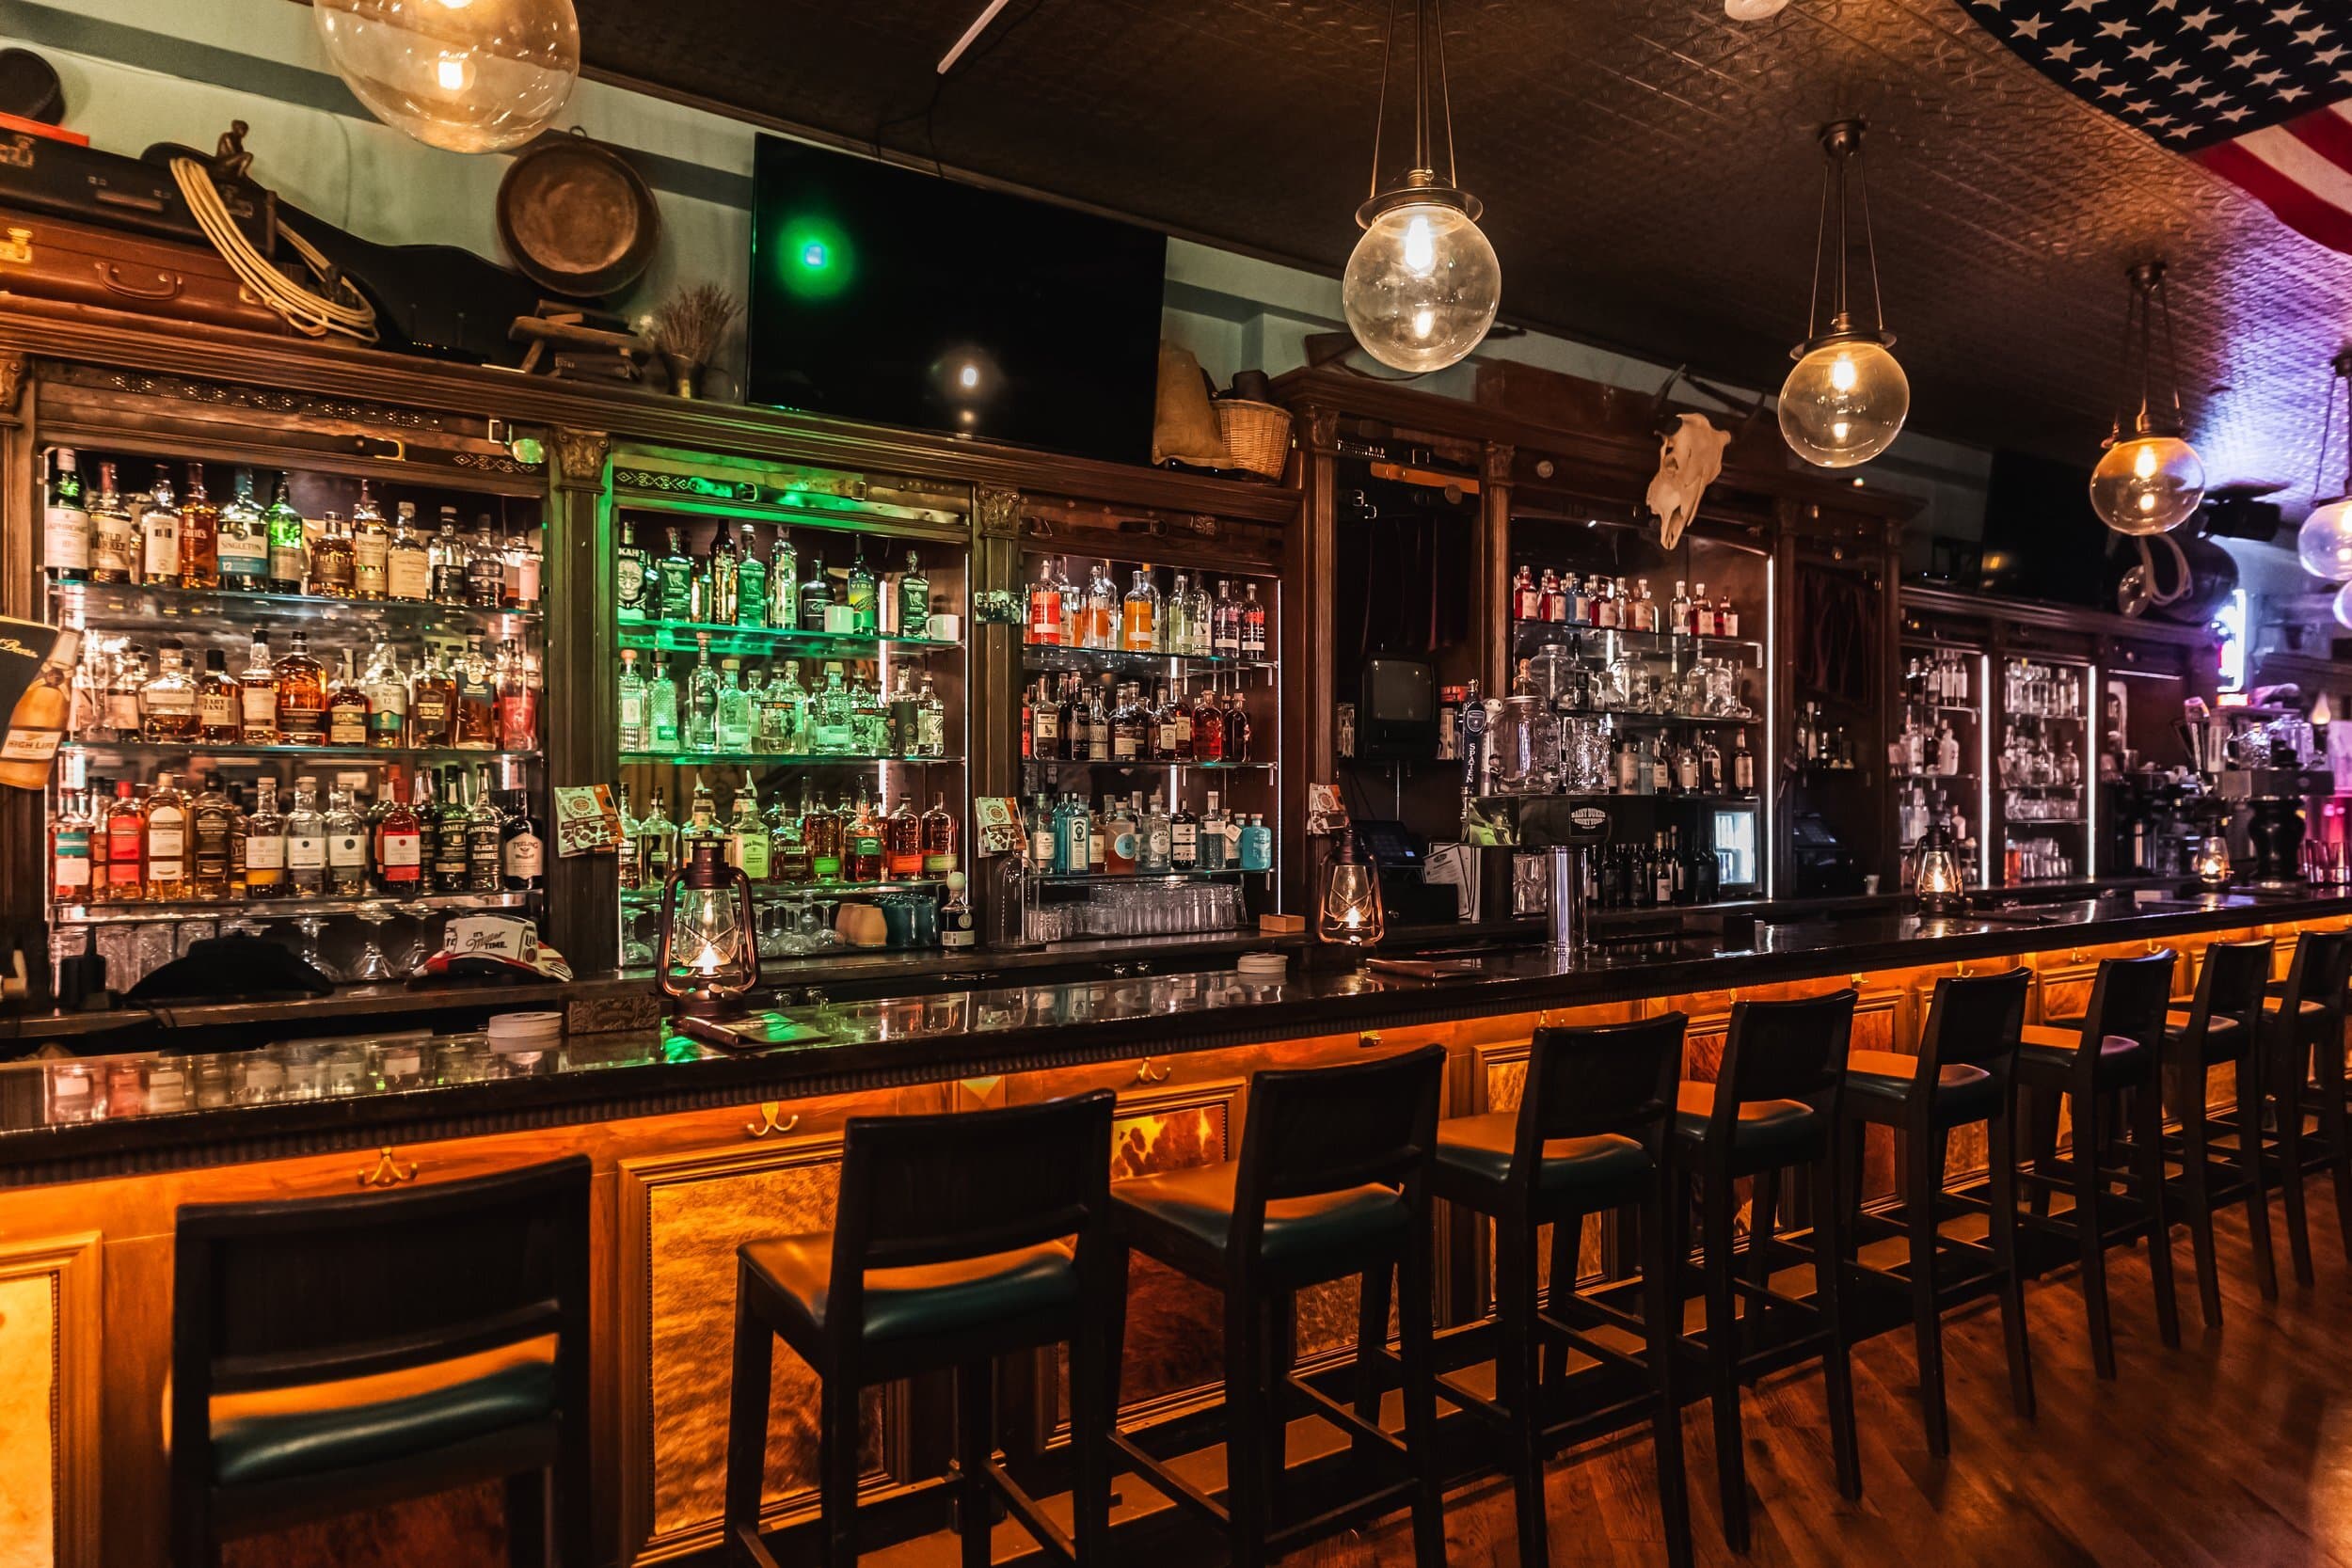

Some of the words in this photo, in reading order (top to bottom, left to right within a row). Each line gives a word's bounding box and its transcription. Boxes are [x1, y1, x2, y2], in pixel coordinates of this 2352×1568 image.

[618, 546, 640, 557] KAH
[1466, 742, 1476, 784] SPATEN
[467, 824, 501, 834] JAMESON
